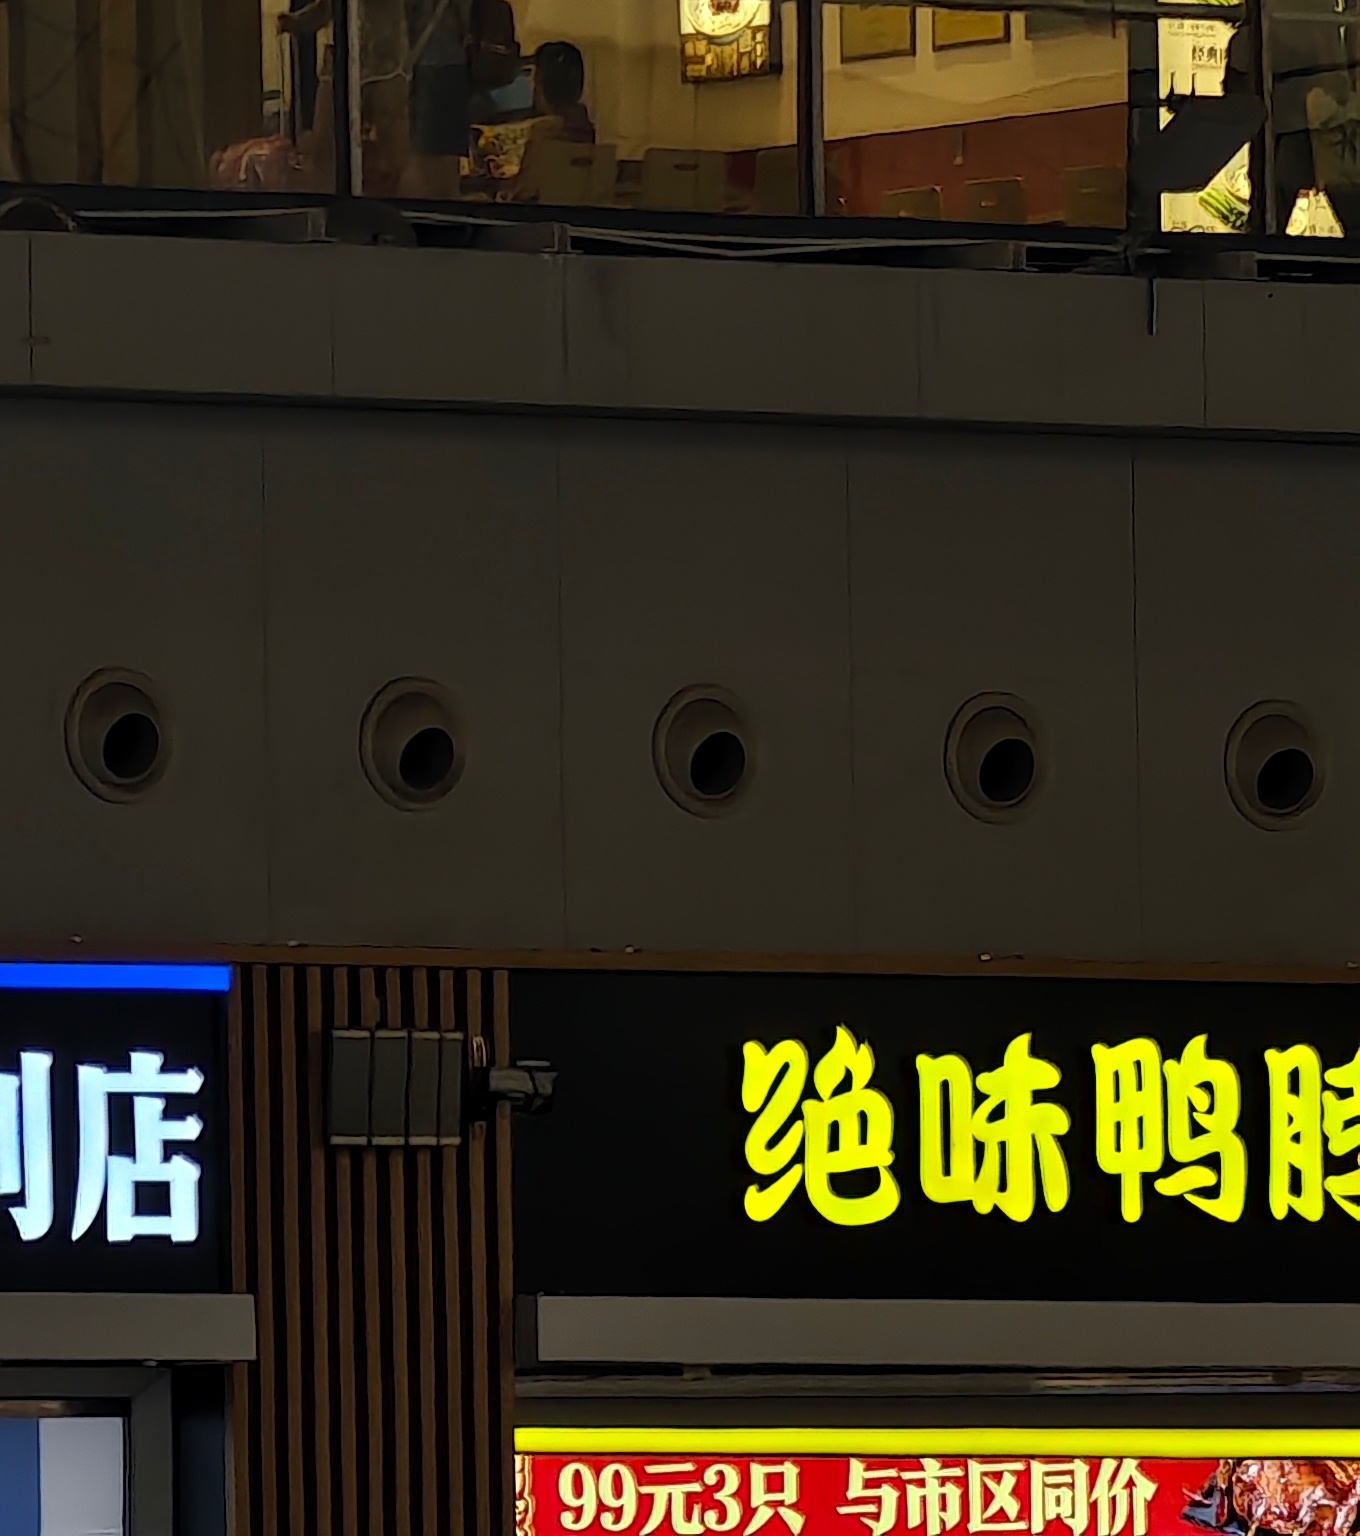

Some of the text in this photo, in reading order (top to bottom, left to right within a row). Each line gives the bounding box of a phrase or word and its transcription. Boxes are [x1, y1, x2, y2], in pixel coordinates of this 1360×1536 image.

[558, 1456, 1158, 1536] 99元3只 与市区同价
